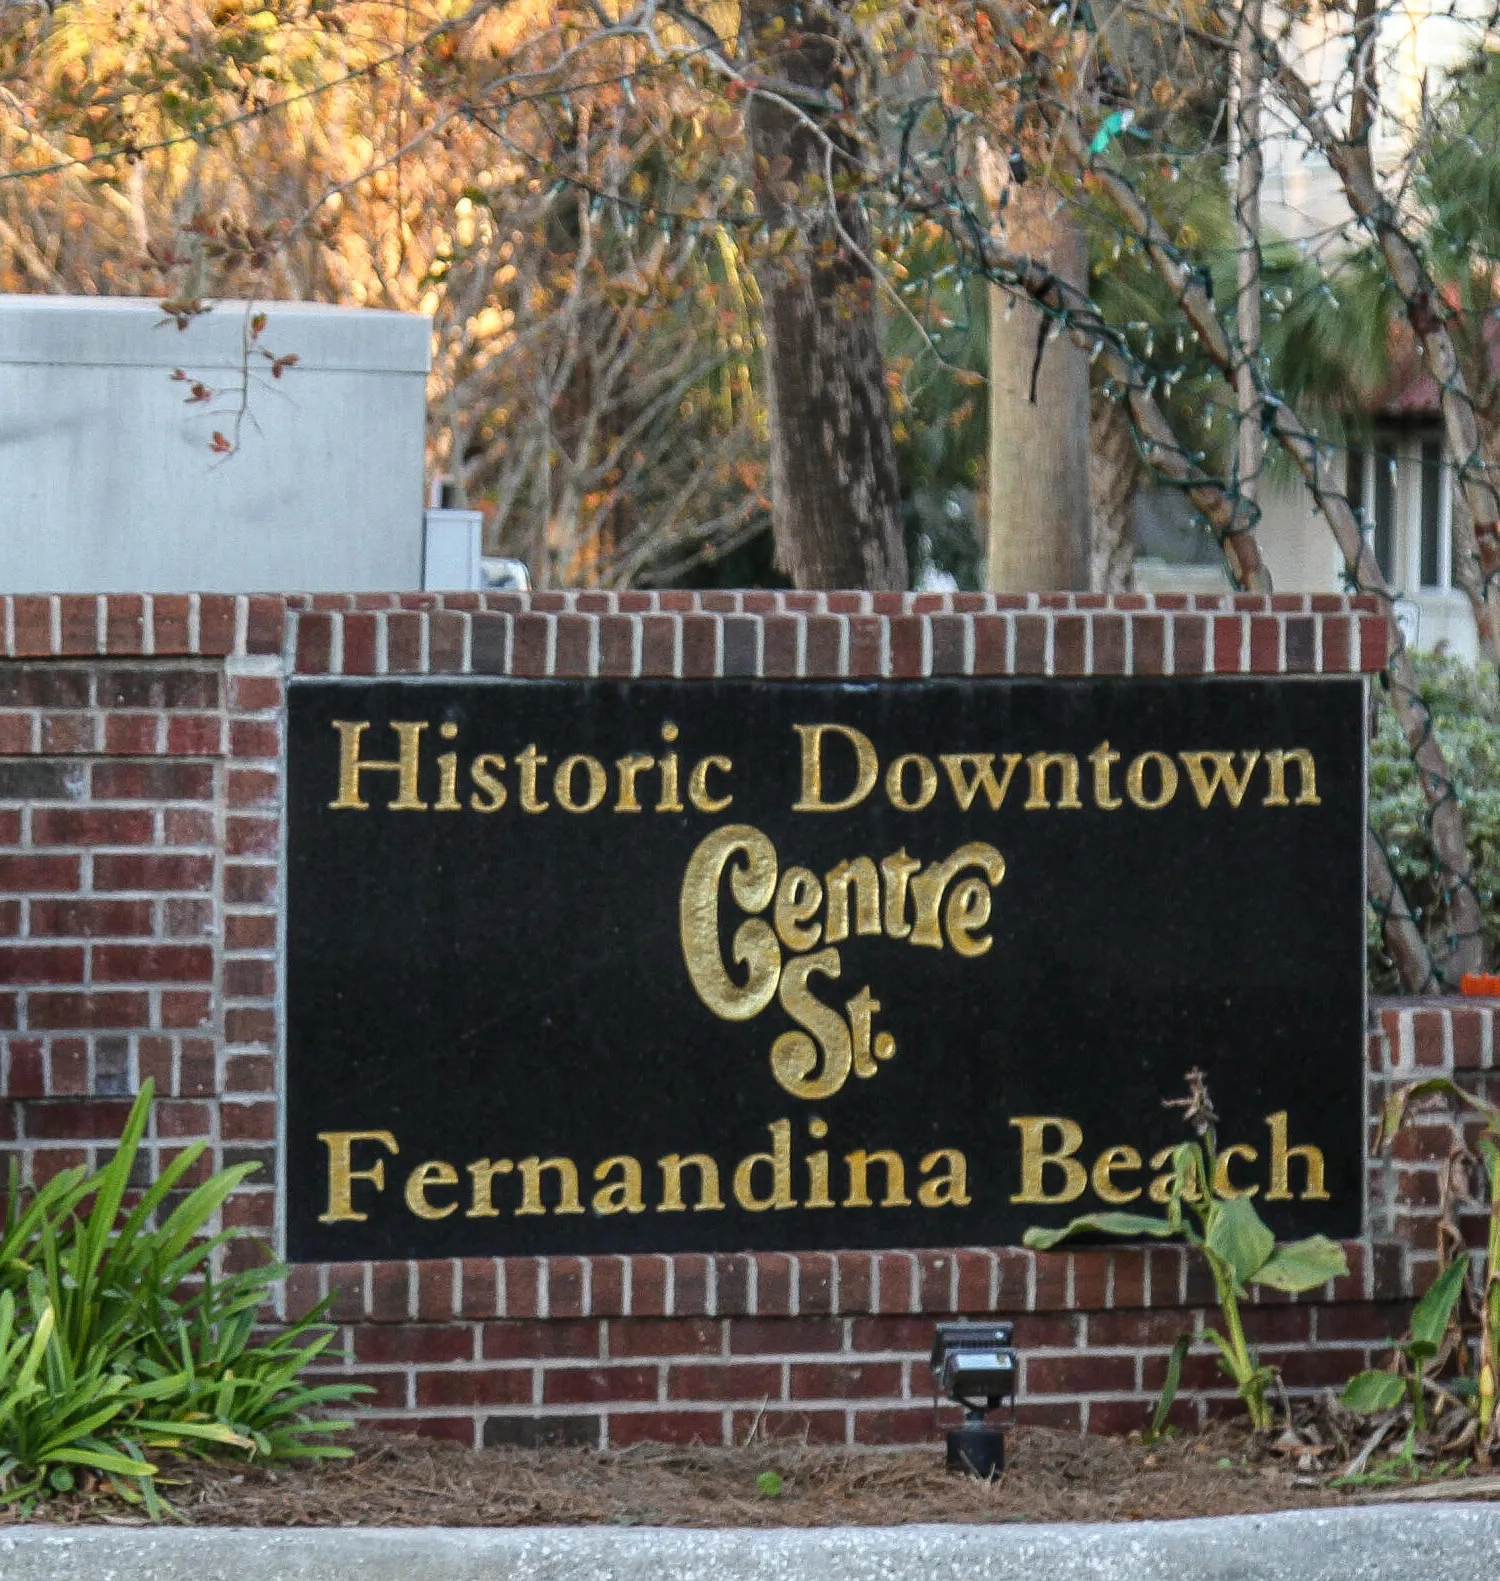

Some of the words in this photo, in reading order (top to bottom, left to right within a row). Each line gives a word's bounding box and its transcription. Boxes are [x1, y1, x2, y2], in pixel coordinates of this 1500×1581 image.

[330, 720, 734, 813] Historic
[792, 723, 1323, 814] Downtown
[680, 824, 1006, 1021] Centre
[769, 948, 896, 1101] St.
[317, 1118, 971, 1224] Fernandina
